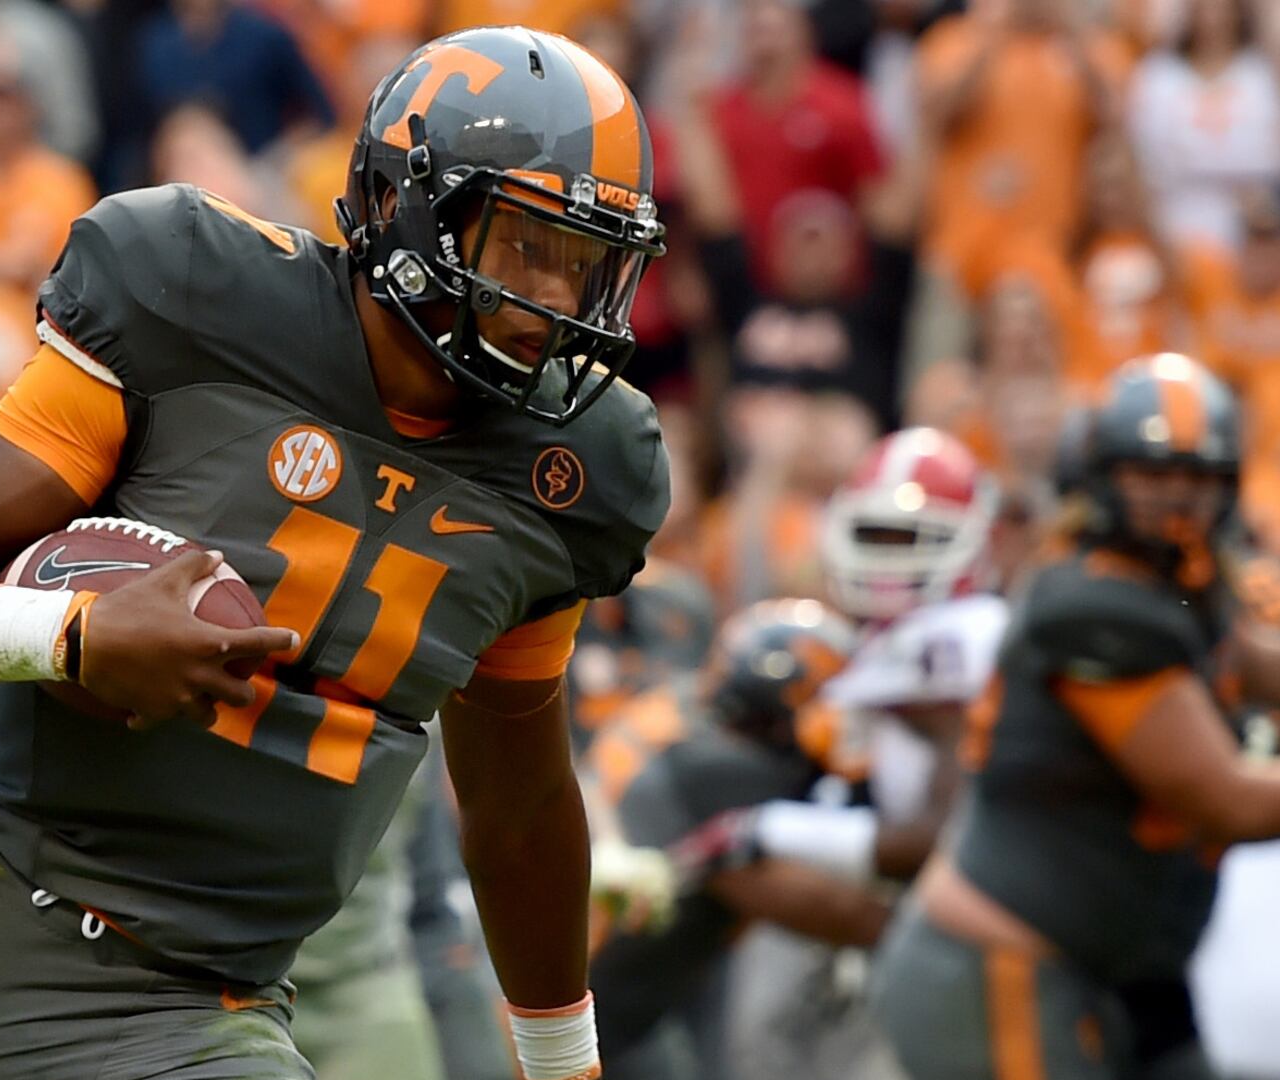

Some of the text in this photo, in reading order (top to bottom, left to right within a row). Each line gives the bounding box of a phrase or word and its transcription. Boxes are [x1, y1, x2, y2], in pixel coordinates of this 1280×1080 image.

[381, 45, 504, 151] T
[597, 182, 640, 211] VOLS
[273, 430, 338, 498] SEC
[375, 463, 417, 513] T
[207, 505, 449, 785] 11
